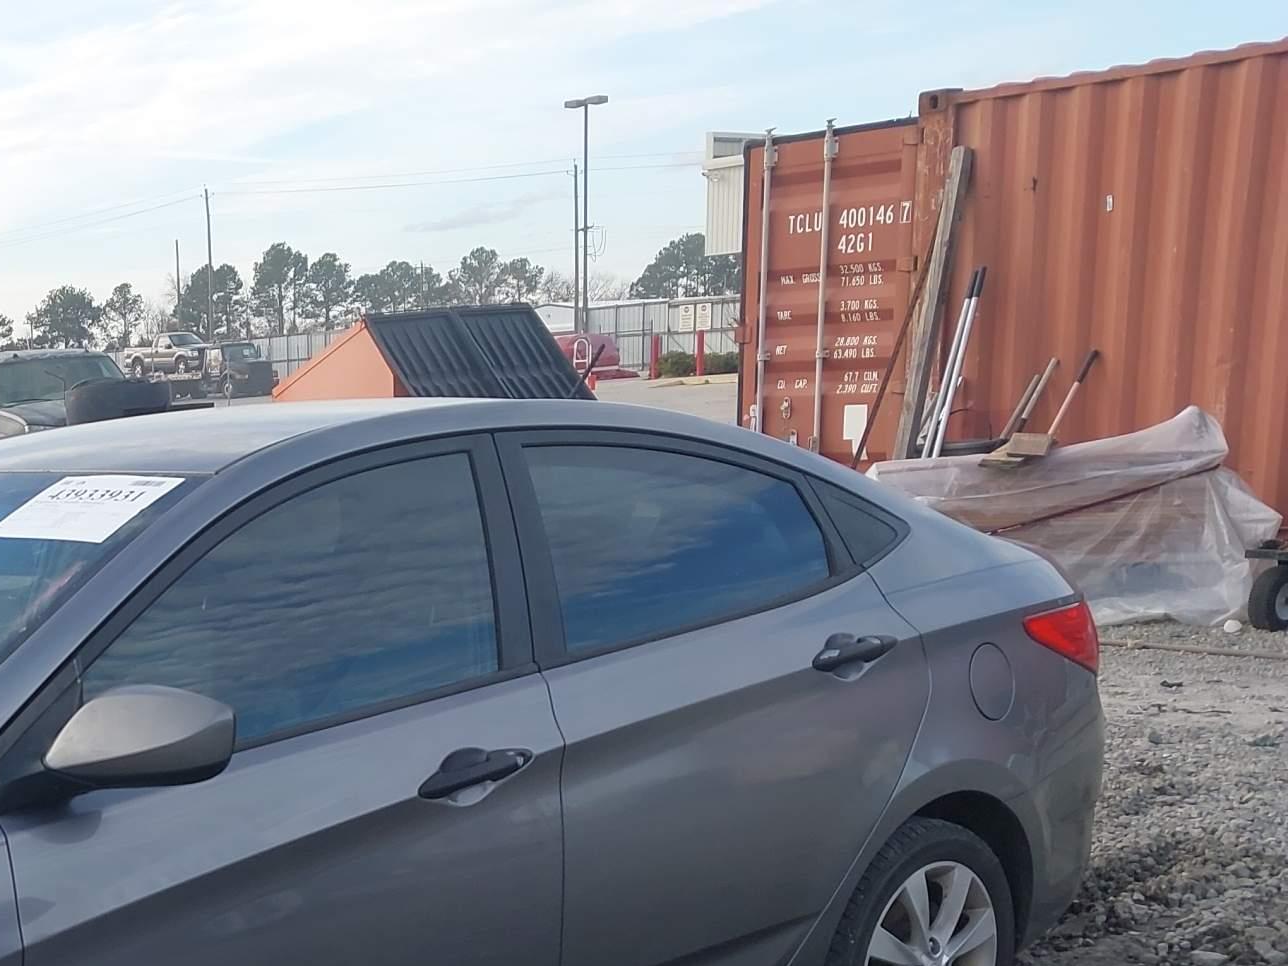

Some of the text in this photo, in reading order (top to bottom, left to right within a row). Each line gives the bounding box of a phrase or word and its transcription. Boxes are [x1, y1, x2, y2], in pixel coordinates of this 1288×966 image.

[789, 212, 822, 234] TCLU
[839, 205, 894, 229] 400146
[838, 232, 873, 254] 42G1
[802, 273, 821, 284] GROSS
[775, 345, 788, 356] NET
[48, 488, 147, 502] 43933931
